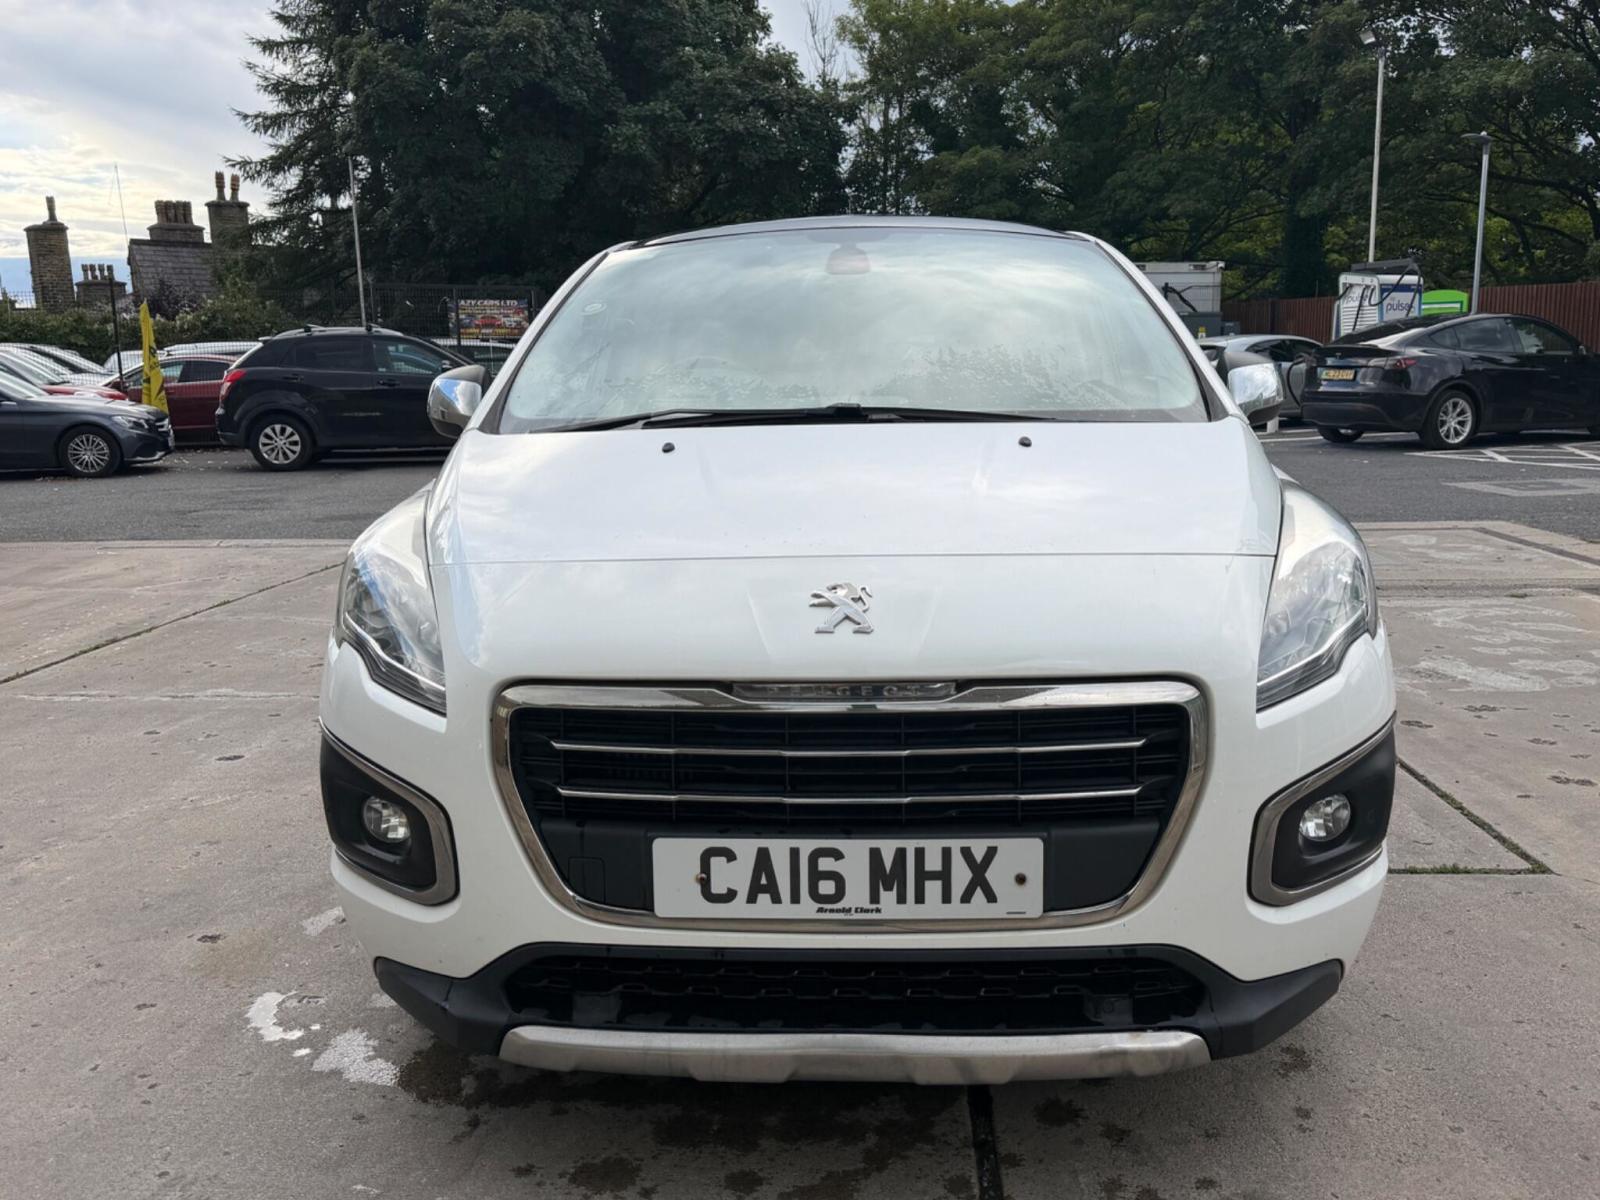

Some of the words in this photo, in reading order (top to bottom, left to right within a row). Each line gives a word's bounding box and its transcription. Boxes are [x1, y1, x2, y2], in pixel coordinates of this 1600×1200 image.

[699, 846, 846, 905] CA16
[869, 846, 998, 905] MHX
[816, 906, 852, 914] Arnold
[854, 906, 882, 914] Clark
